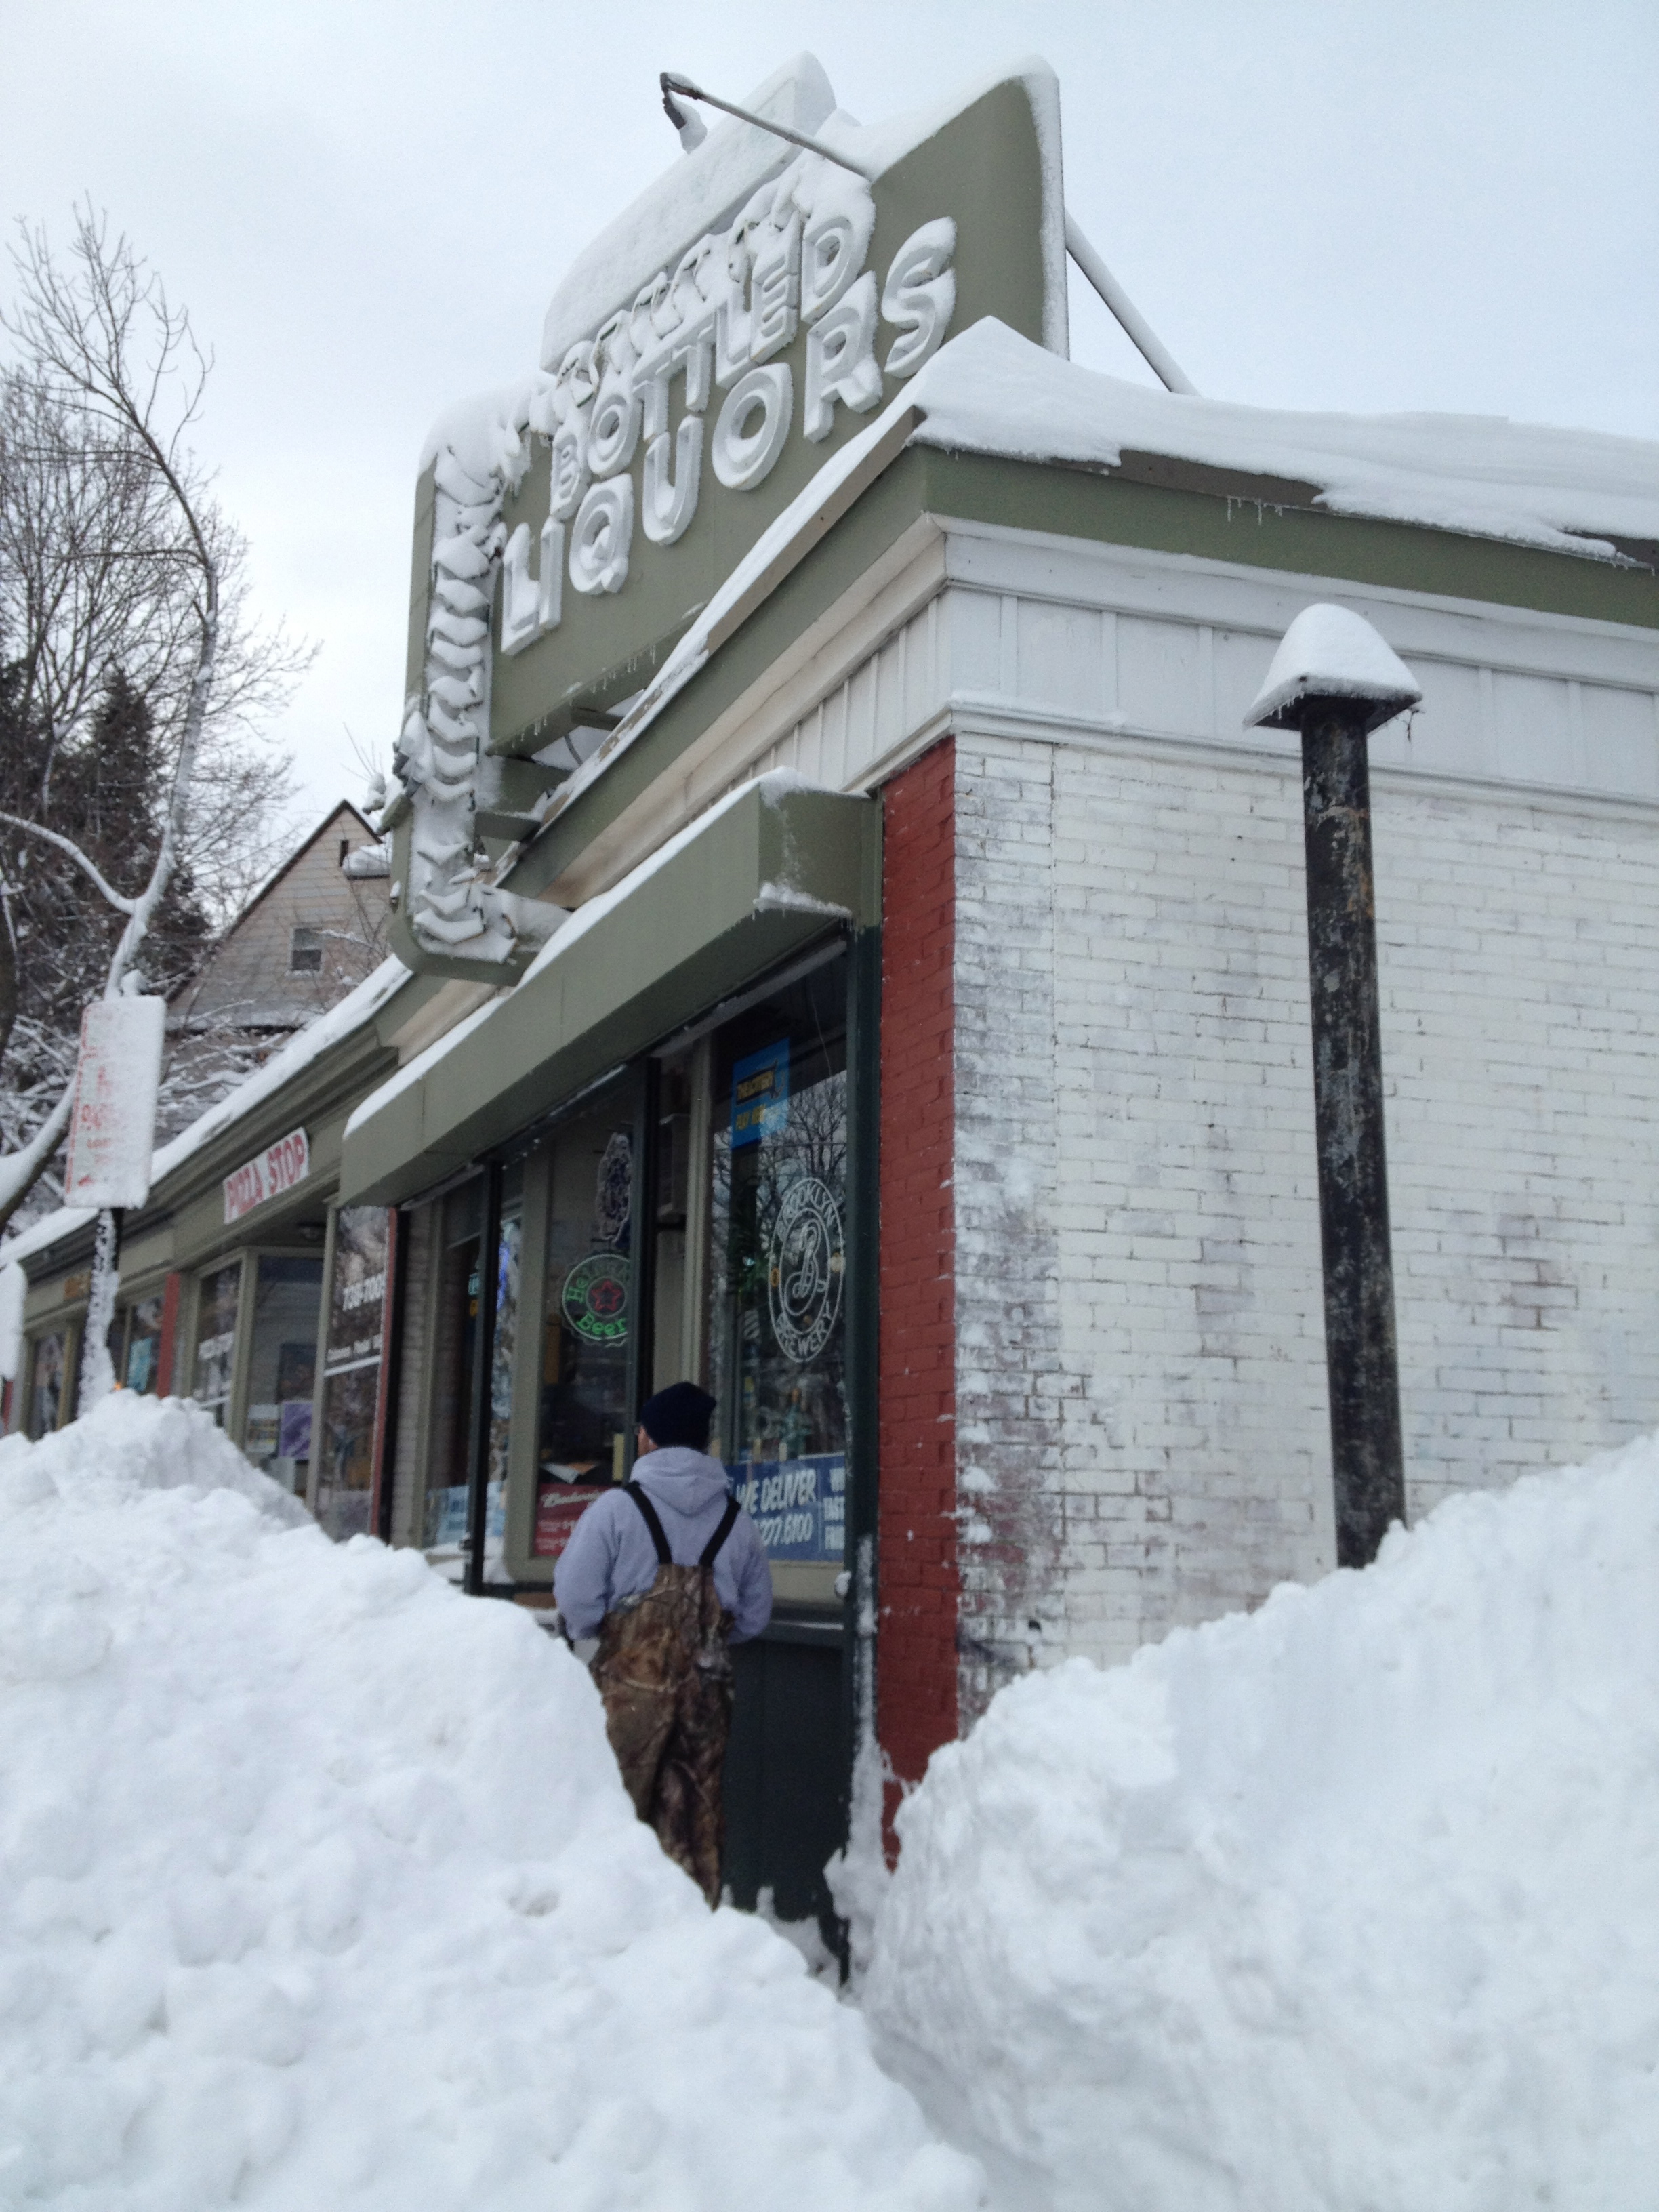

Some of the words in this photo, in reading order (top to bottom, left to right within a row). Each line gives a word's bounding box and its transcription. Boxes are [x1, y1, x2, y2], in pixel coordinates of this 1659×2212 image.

[550, 203, 873, 520] BOTTLED
[501, 216, 958, 655] LIQUORS
[227, 1162, 264, 1220] PIZZA
[267, 1134, 305, 1196] STOP
[576, 1311, 627, 1336] Beer
[736, 1480, 759, 1515] WE
[760, 1468, 816, 1513] DELIVER
